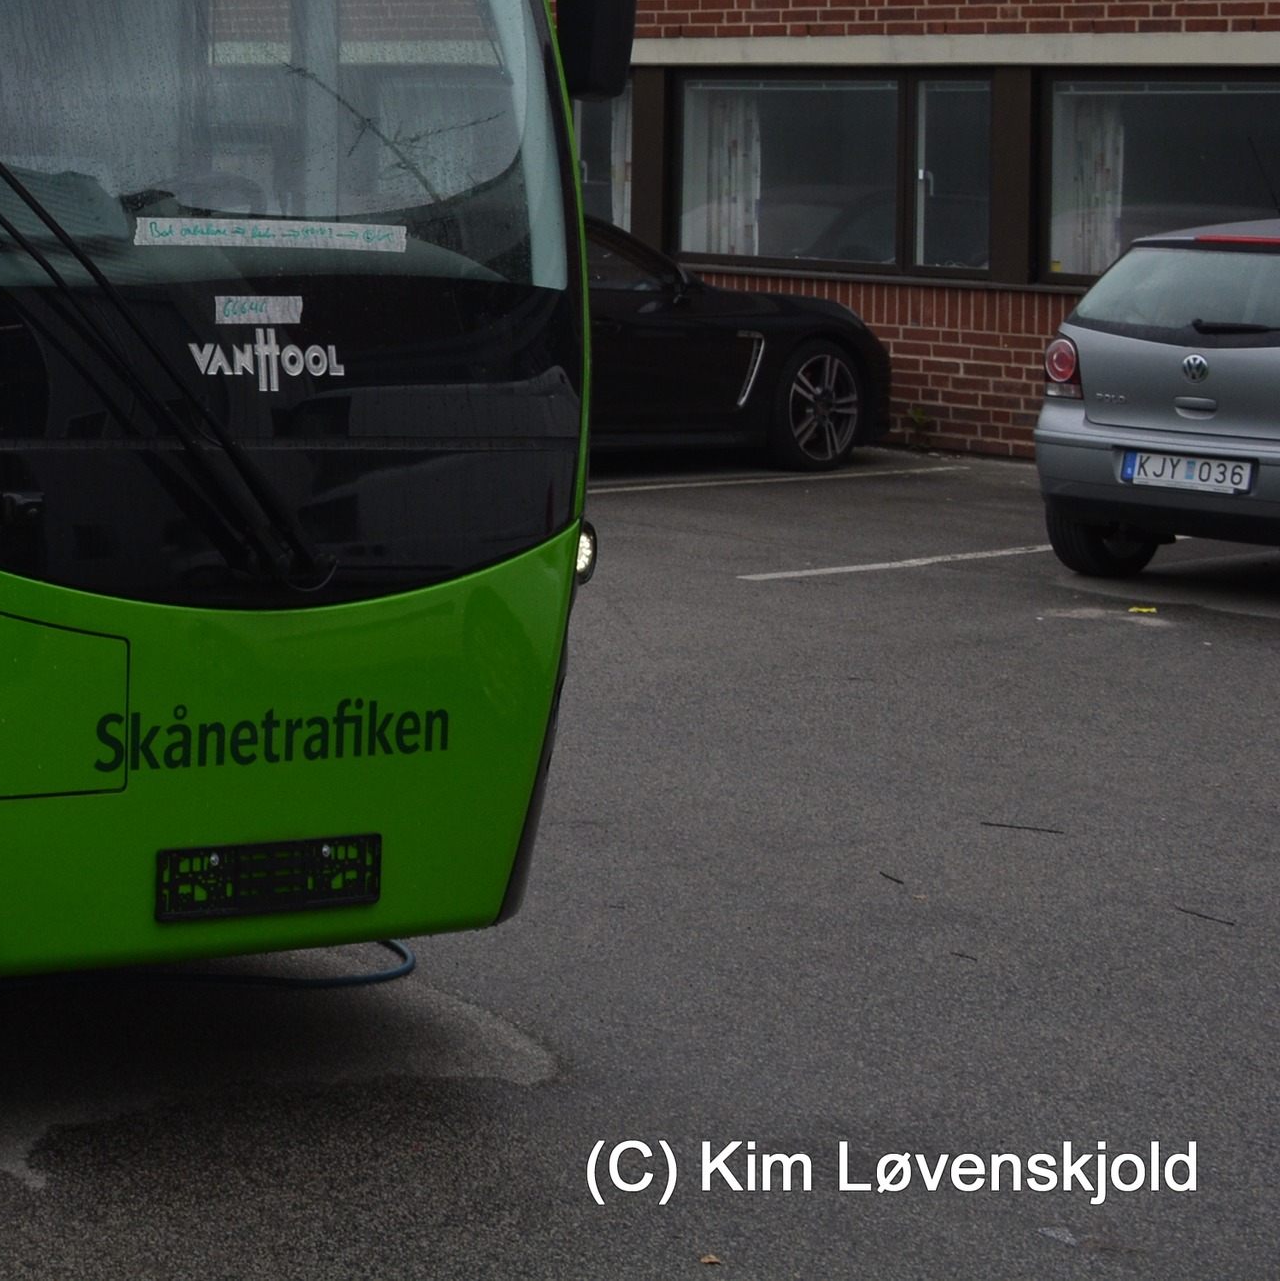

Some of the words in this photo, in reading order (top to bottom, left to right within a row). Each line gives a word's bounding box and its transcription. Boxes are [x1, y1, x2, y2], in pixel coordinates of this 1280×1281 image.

[1136, 455, 1182, 480] KJY
[1198, 461, 1245, 486] 036
[93, 697, 450, 773] Skånetrafiken
